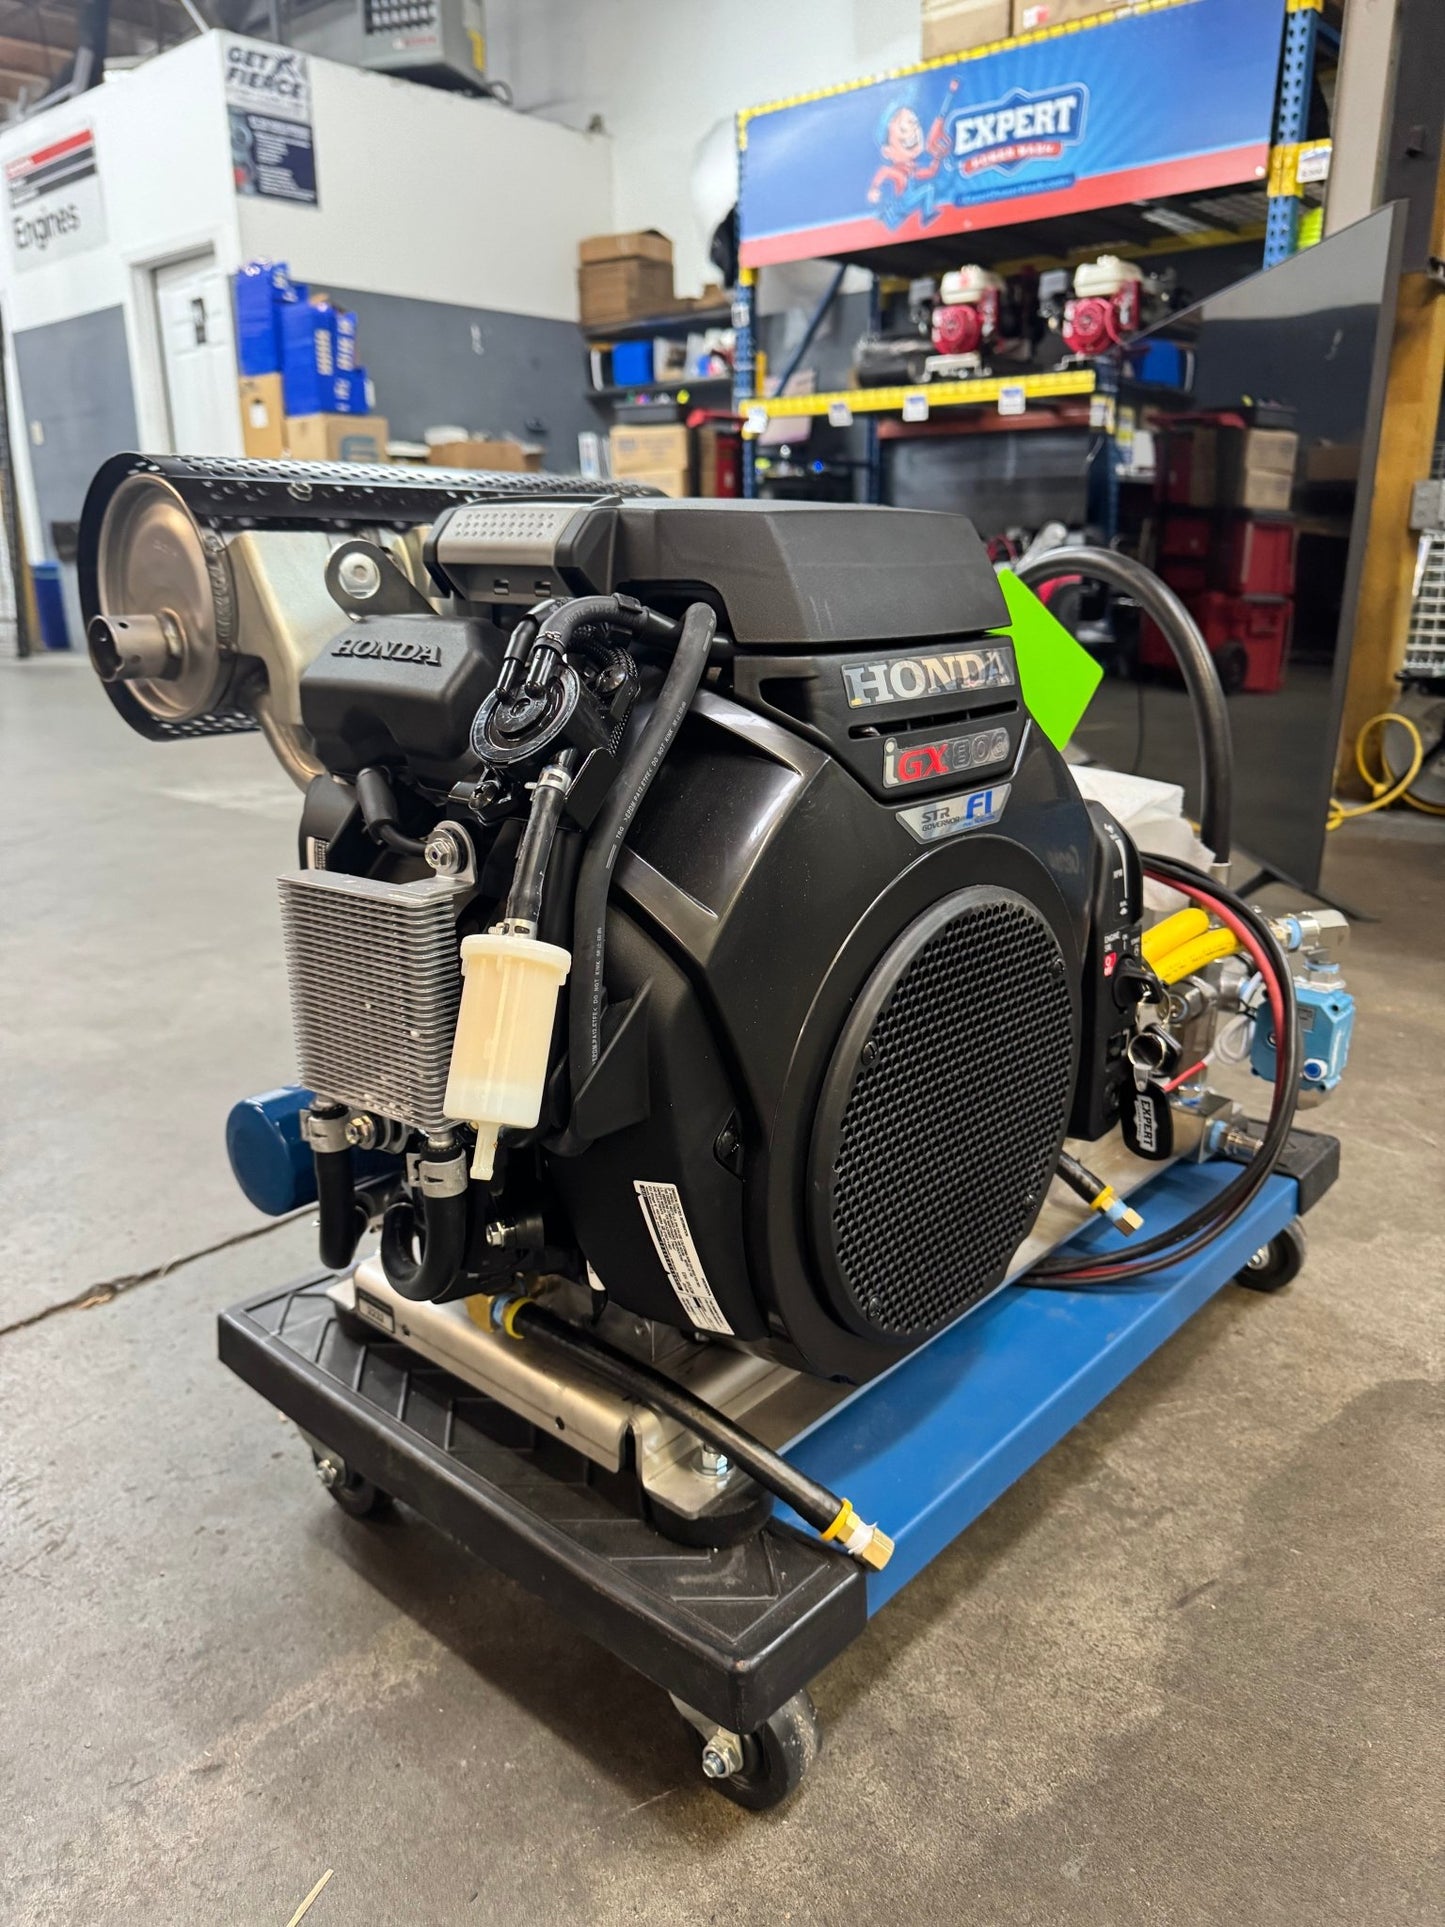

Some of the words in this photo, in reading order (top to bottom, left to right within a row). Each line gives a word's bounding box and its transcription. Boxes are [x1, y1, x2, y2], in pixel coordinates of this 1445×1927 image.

[227, 46, 269, 71] GET
[227, 67, 302, 99] FIERCE
[954, 95, 1077, 156] EXPERT
[13, 203, 81, 249] Engines
[331, 639, 442, 667] HONDA
[844, 651, 1012, 706] HONDA
[657, 743, 666, 757] NOT
[664, 730, 674, 744] KINK
[921, 807, 950, 824] STR
[966, 790, 993, 819] FI
[922, 814, 961, 832] GOVERNOR
[1141, 1099, 1153, 1148] EXPERT
